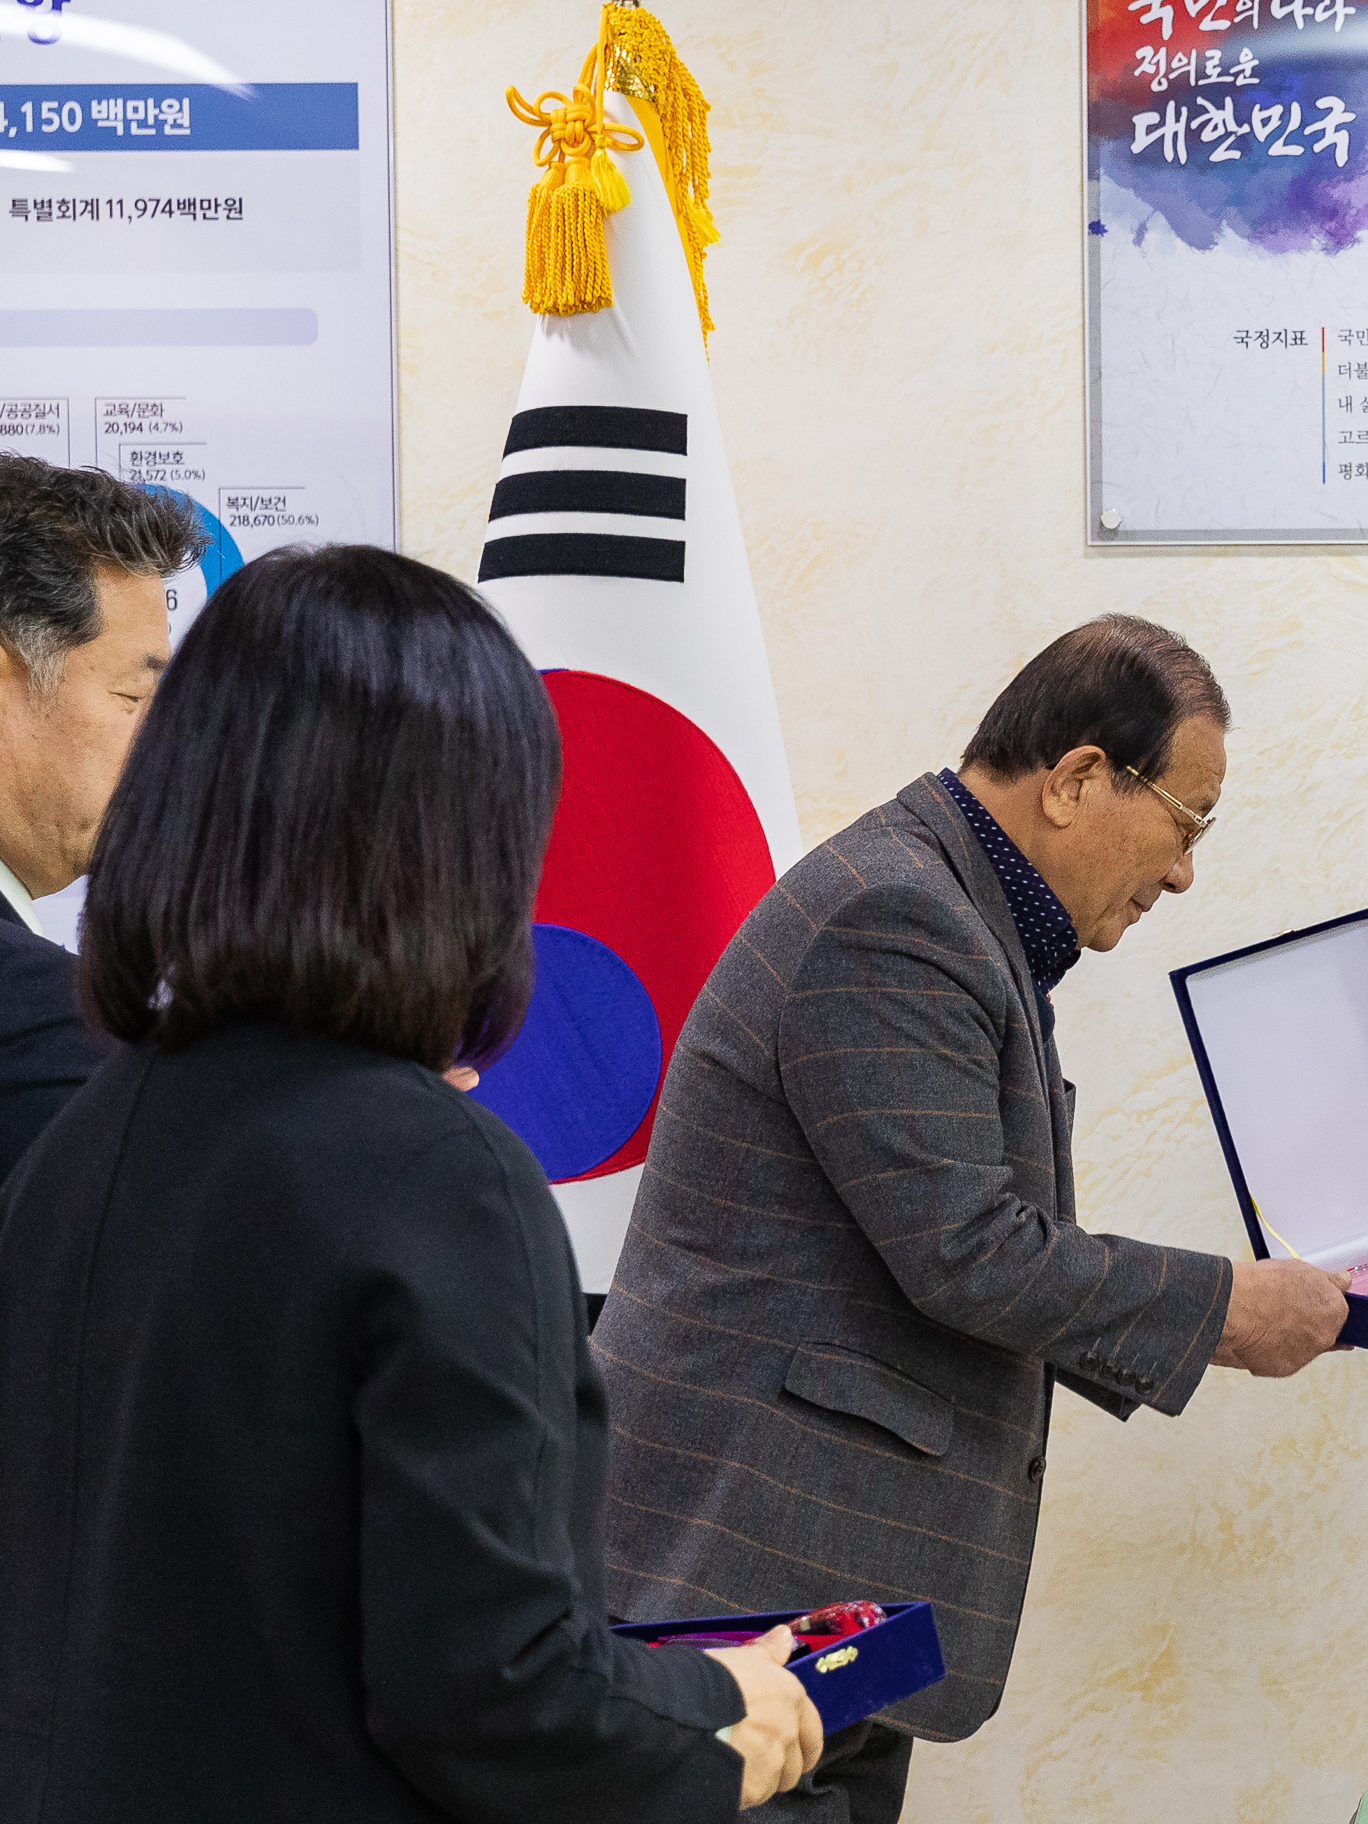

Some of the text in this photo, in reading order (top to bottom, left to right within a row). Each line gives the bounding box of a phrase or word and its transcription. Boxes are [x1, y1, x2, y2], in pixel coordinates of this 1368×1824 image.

[1133, 45, 1261, 92] 정의로운
[91, 97, 191, 136] 백만원
[1130, 96, 1357, 168] 대한민국
[9, 197, 243, 224] 특별회계 11,974백만원
[1233, 328, 1308, 349] 국정지표
[103, 402, 164, 419] 교육/문화
[1337, 395, 1353, 413] 내
[104, 422, 143, 436] 20,194
[129, 450, 185, 466] 환경보호
[226, 495, 287, 512] 복지/보건
